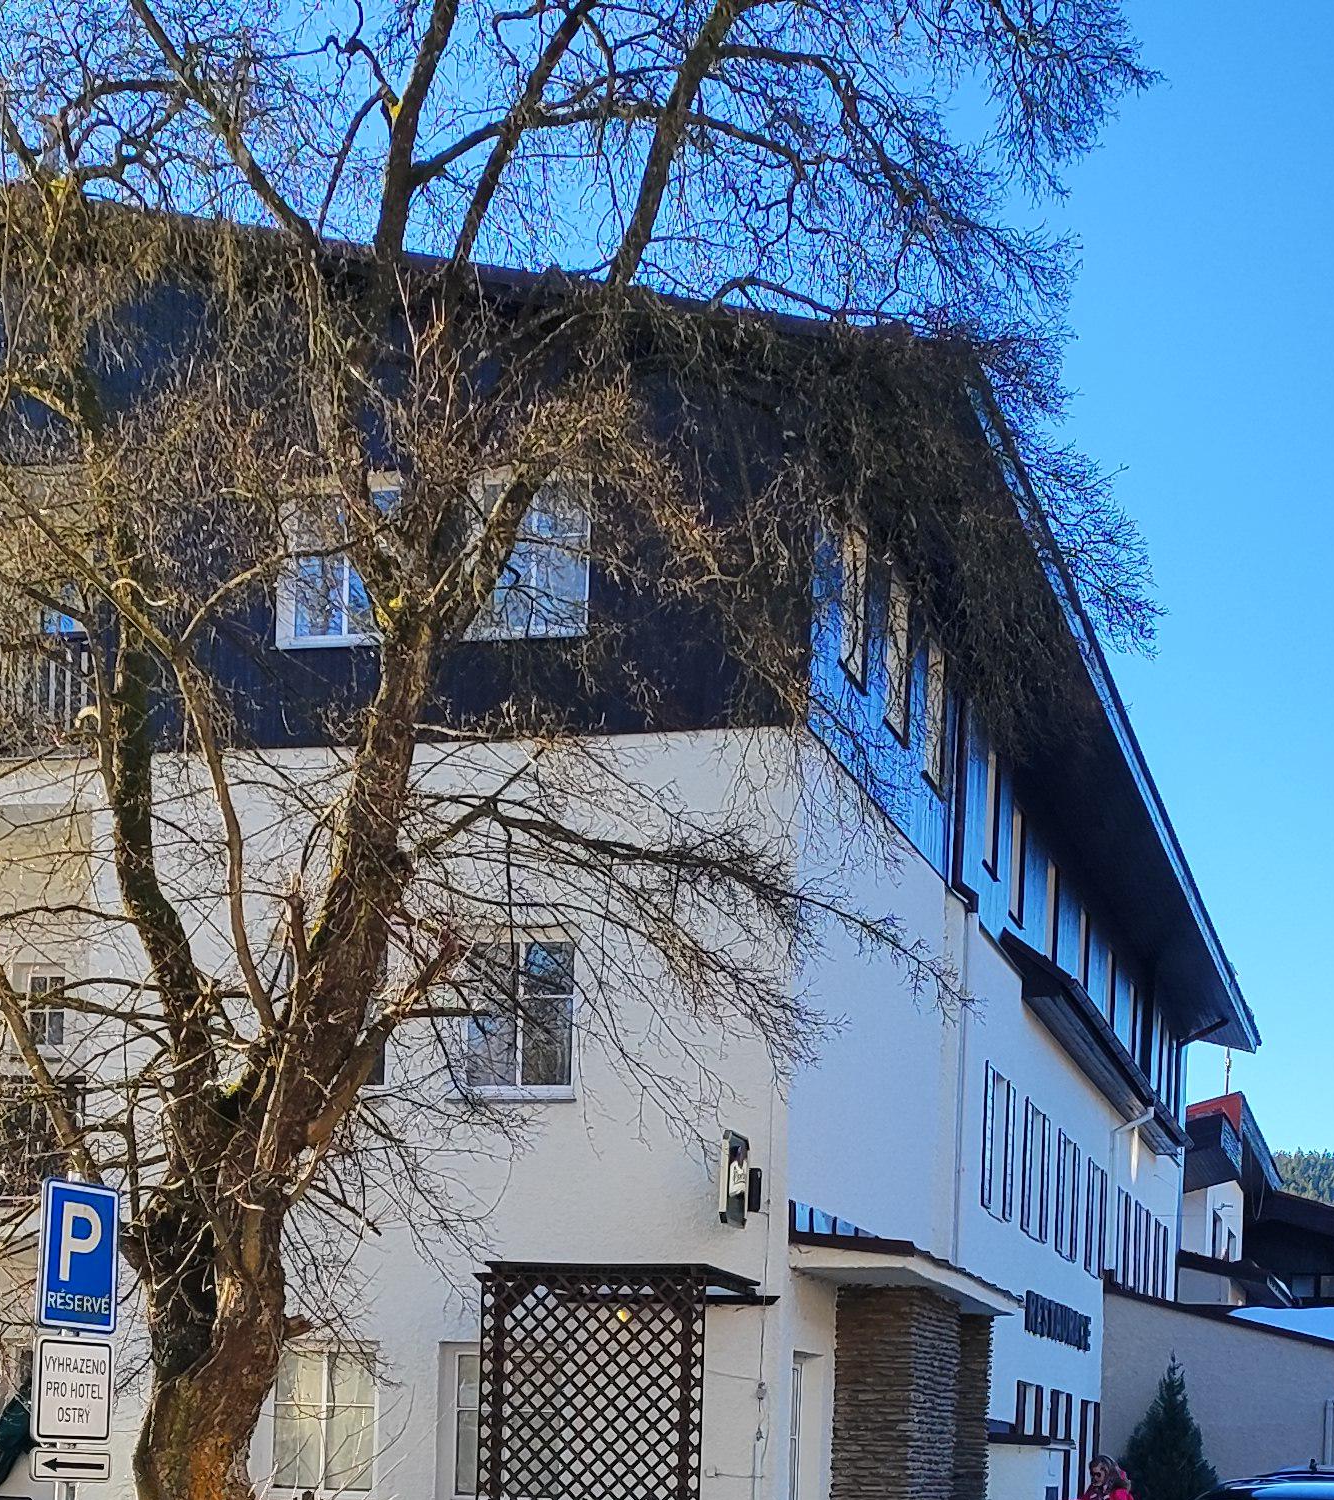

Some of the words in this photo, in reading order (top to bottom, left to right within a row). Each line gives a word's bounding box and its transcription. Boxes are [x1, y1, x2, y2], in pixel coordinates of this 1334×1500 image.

[58, 1200, 102, 1282] P
[44, 1354, 107, 1376] VYHRAZENO
[45, 1381, 67, 1399] PRO
[70, 1382, 104, 1400] HOTEL
[56, 1405, 92, 1425] OSTRÝ
